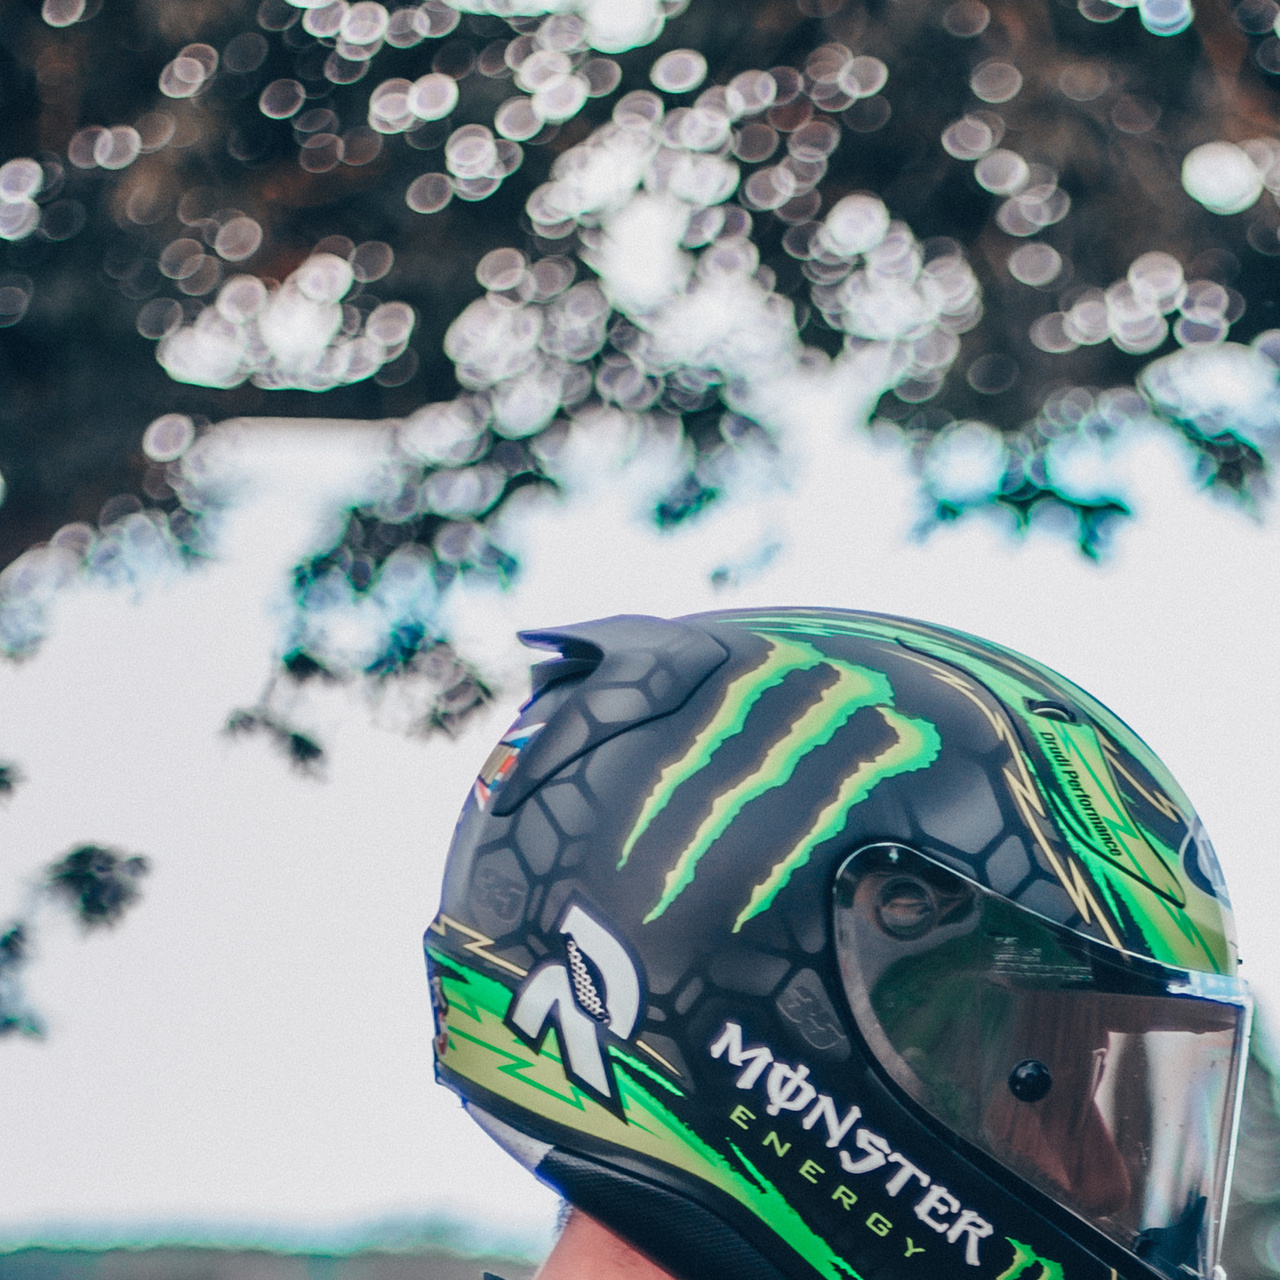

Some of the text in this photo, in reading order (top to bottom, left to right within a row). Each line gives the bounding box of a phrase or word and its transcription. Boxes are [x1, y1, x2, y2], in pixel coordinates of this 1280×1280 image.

[1039, 731, 1123, 858] Drudi Performance
[710, 1021, 995, 1267] MONSTER
[728, 1103, 926, 1258] ENERGY
